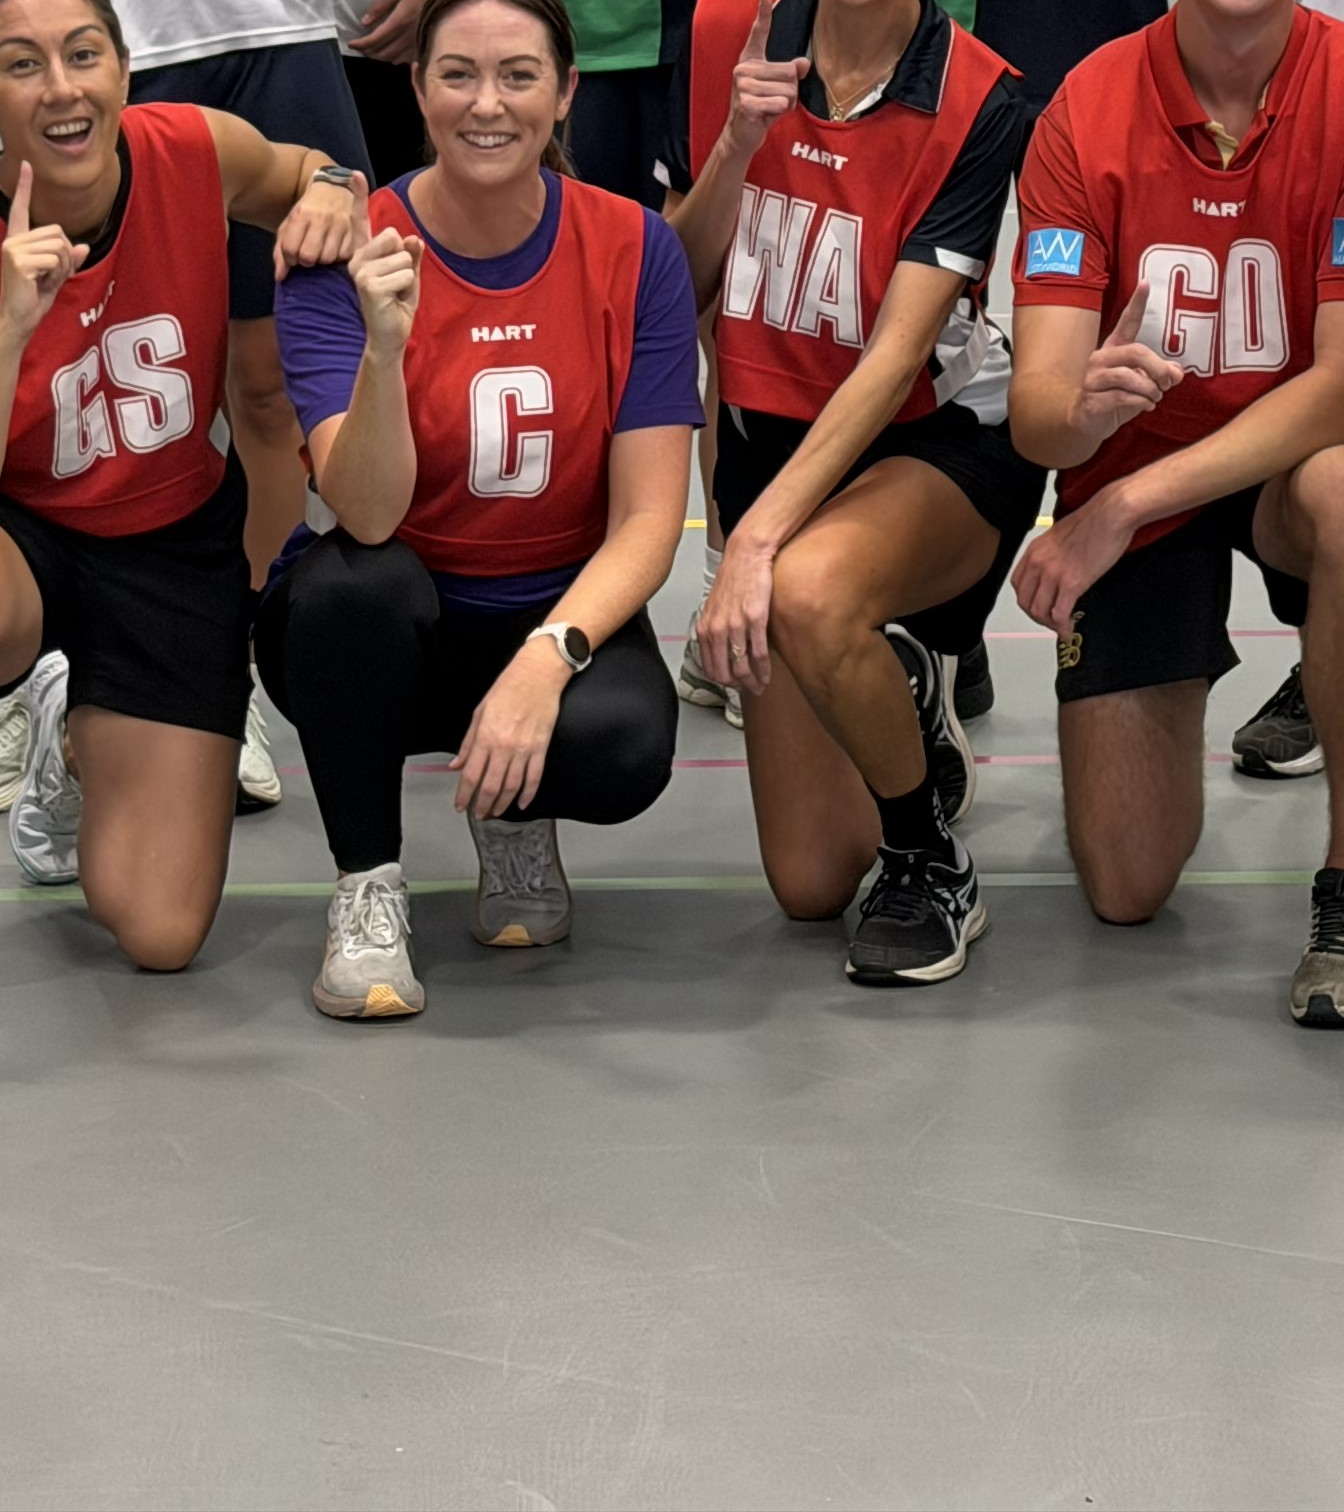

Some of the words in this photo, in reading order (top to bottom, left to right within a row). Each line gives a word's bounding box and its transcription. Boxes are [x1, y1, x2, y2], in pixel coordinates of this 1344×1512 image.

[791, 141, 849, 171] HART
[1192, 197, 1247, 218] HART
[470, 323, 537, 343] HART
[722, 182, 865, 350] WA
[1135, 237, 1291, 378] GD
[51, 313, 194, 480] GS
[468, 365, 554, 499] C
